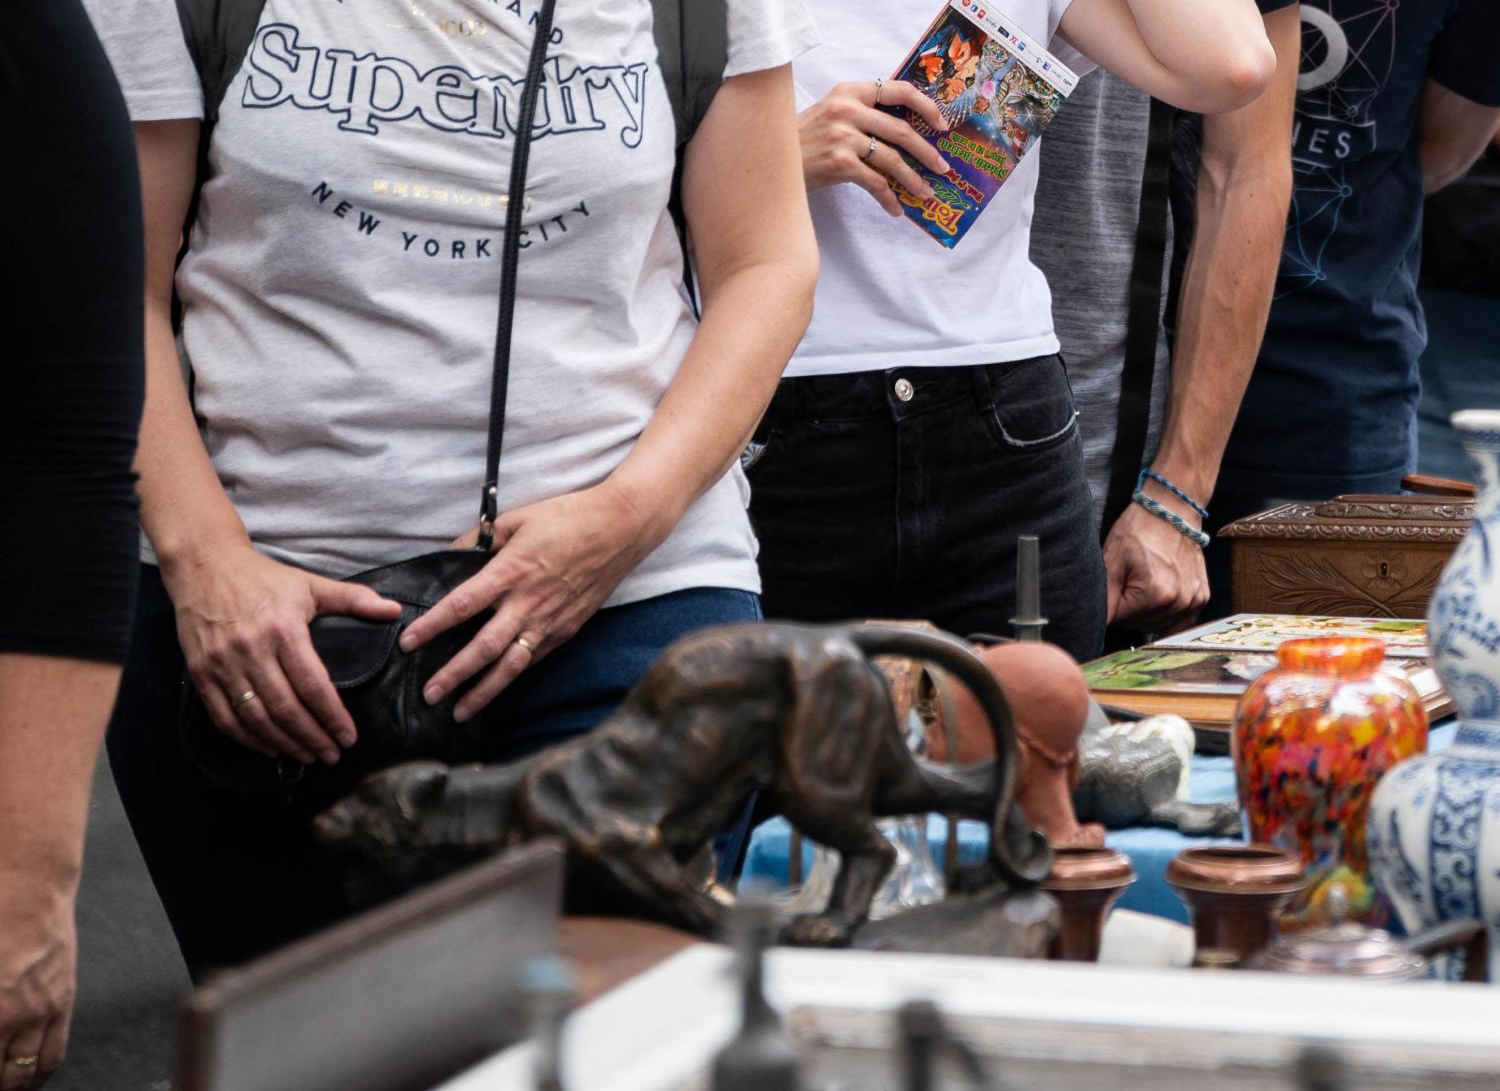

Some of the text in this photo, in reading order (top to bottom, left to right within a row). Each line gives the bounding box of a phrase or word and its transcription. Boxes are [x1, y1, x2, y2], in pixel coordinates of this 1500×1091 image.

[242, 22, 648, 149] Superdry
[311, 181, 381, 237] NEW
[401, 231, 492, 259] YORK
[516, 201, 591, 250] CITY
[922, 194, 965, 236] Foir
